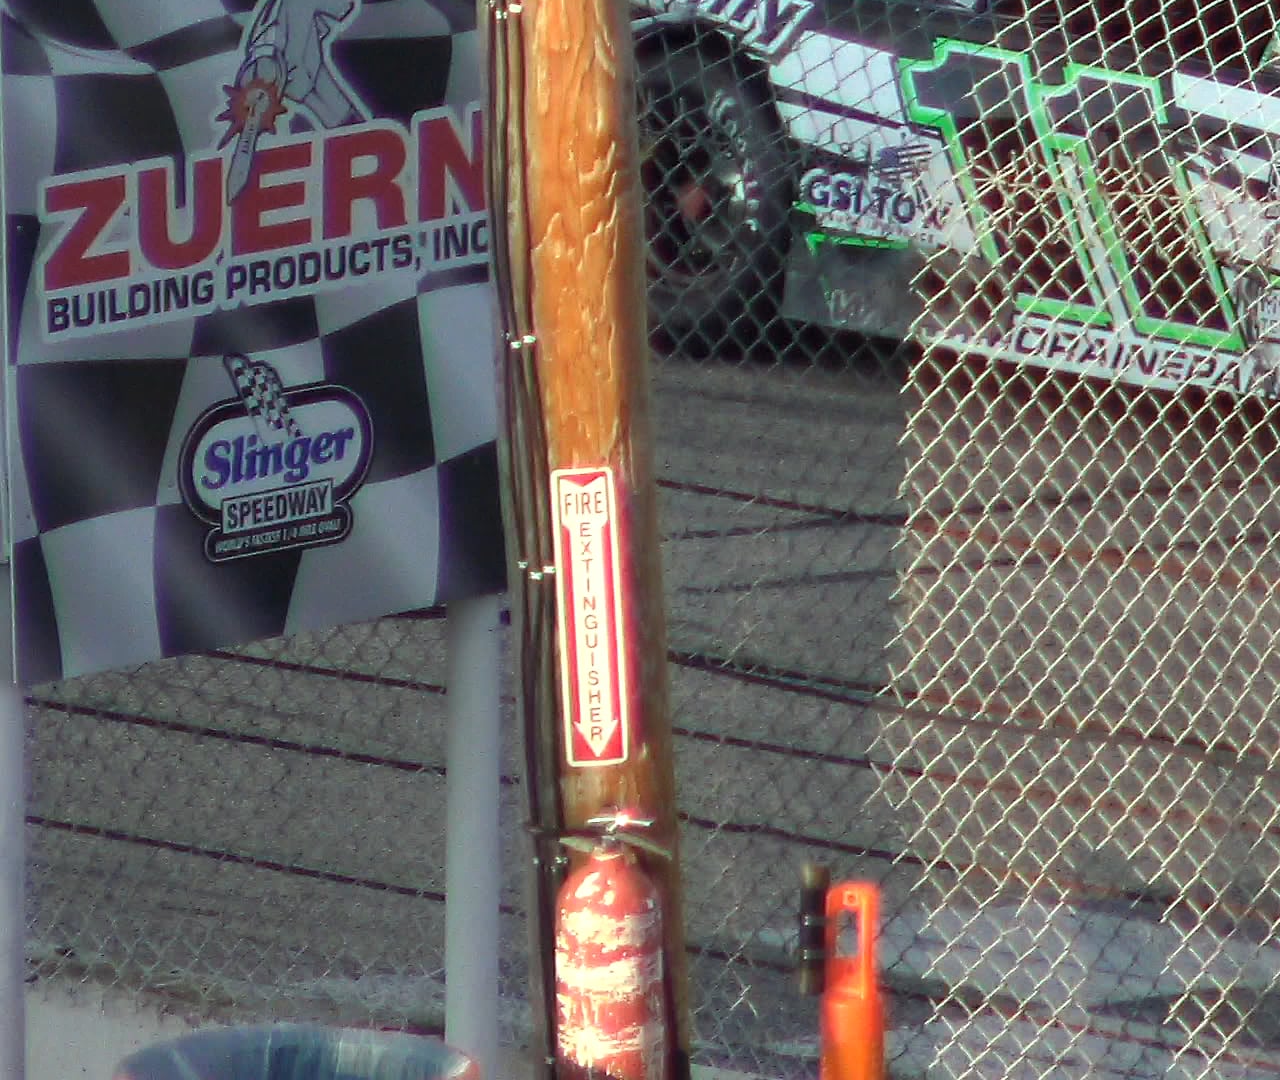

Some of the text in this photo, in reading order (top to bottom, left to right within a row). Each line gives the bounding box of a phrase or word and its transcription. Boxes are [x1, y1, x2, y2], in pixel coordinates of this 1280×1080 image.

[44, 109, 488, 291] ZUERN
[47, 272, 214, 334] BUILDING
[225, 233, 422, 301] PRODUCTS,
[201, 426, 355, 490] Slinger
[226, 483, 330, 530] SPEEDWAY
[564, 491, 604, 517] FIRE
[578, 522, 604, 740] EXTINGUISHER
